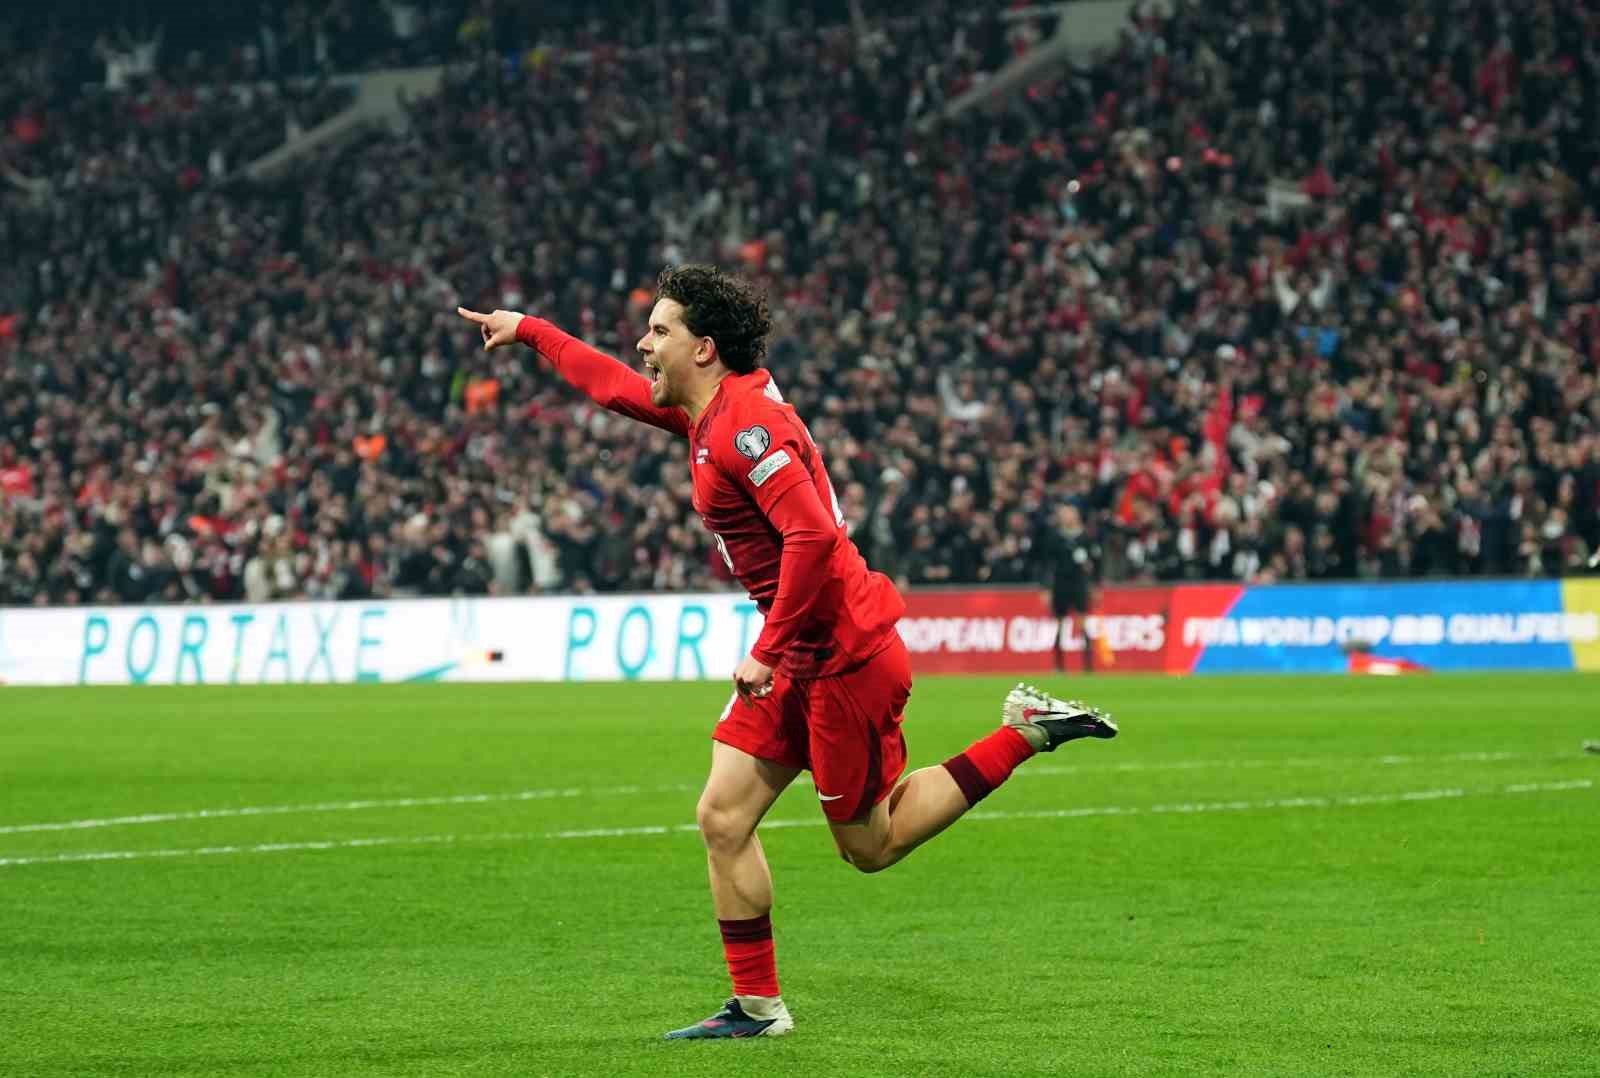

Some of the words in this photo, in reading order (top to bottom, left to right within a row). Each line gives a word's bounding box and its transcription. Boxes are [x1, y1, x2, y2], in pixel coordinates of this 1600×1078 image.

[80, 608, 386, 684] PORTAXE
[564, 603, 757, 680] PORT
[894, 617, 1005, 652] ROPEAN
[1240, 617, 1335, 646] WORLD
